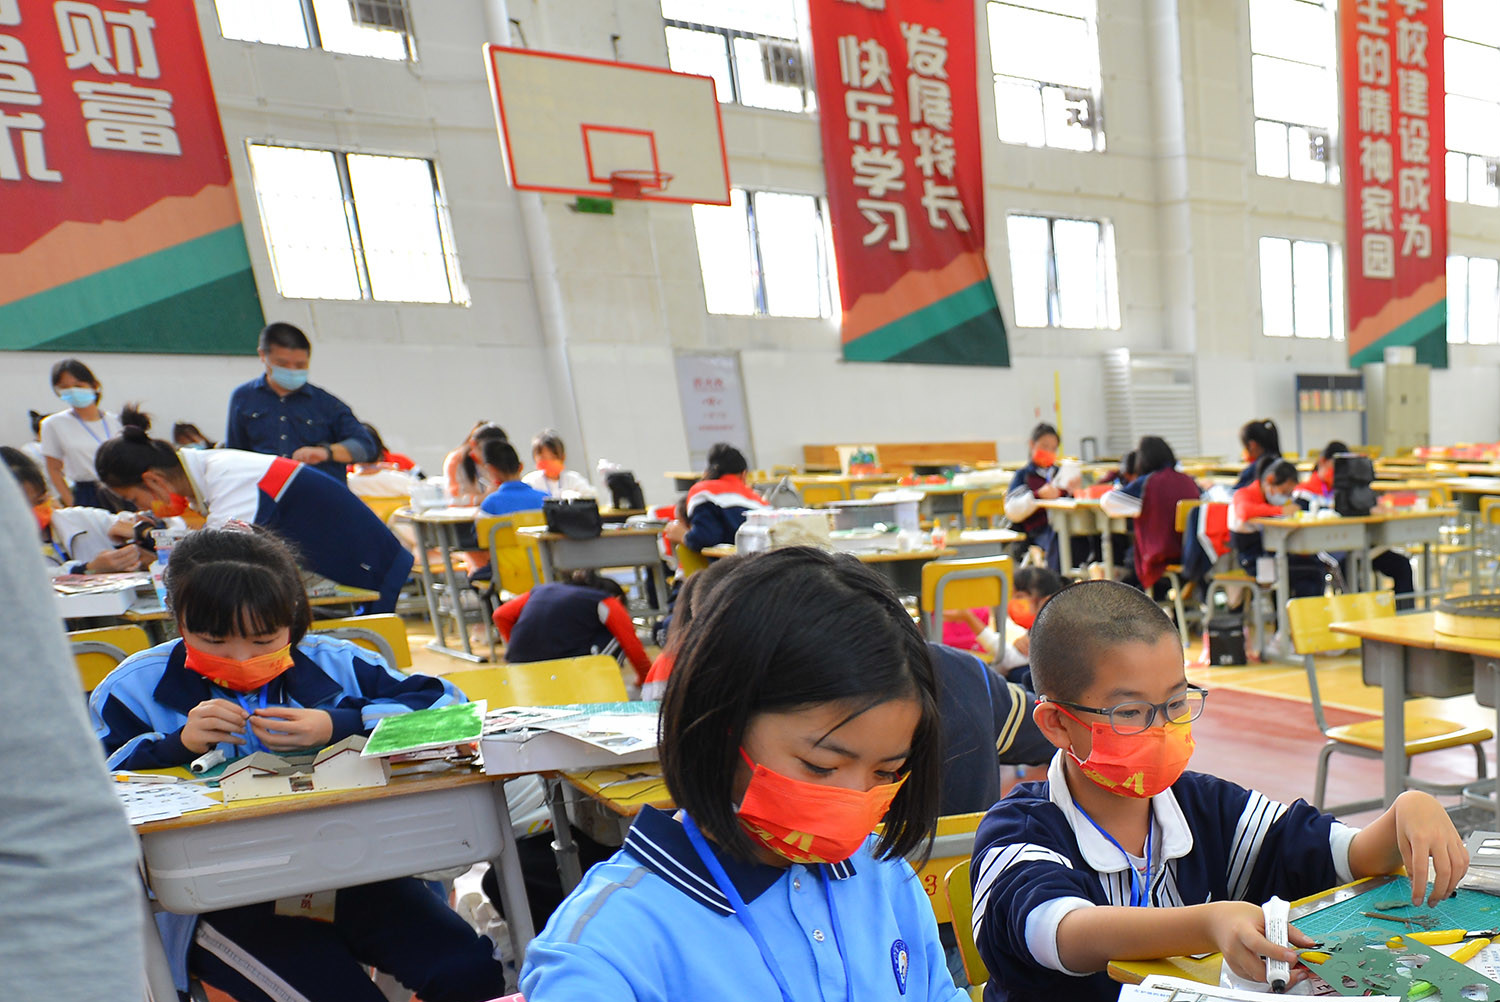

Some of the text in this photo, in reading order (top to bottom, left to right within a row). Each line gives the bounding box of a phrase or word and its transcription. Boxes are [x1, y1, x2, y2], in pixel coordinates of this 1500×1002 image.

[838, 35, 910, 251] 快乐学习
[900, 21, 970, 232] 发展特长
